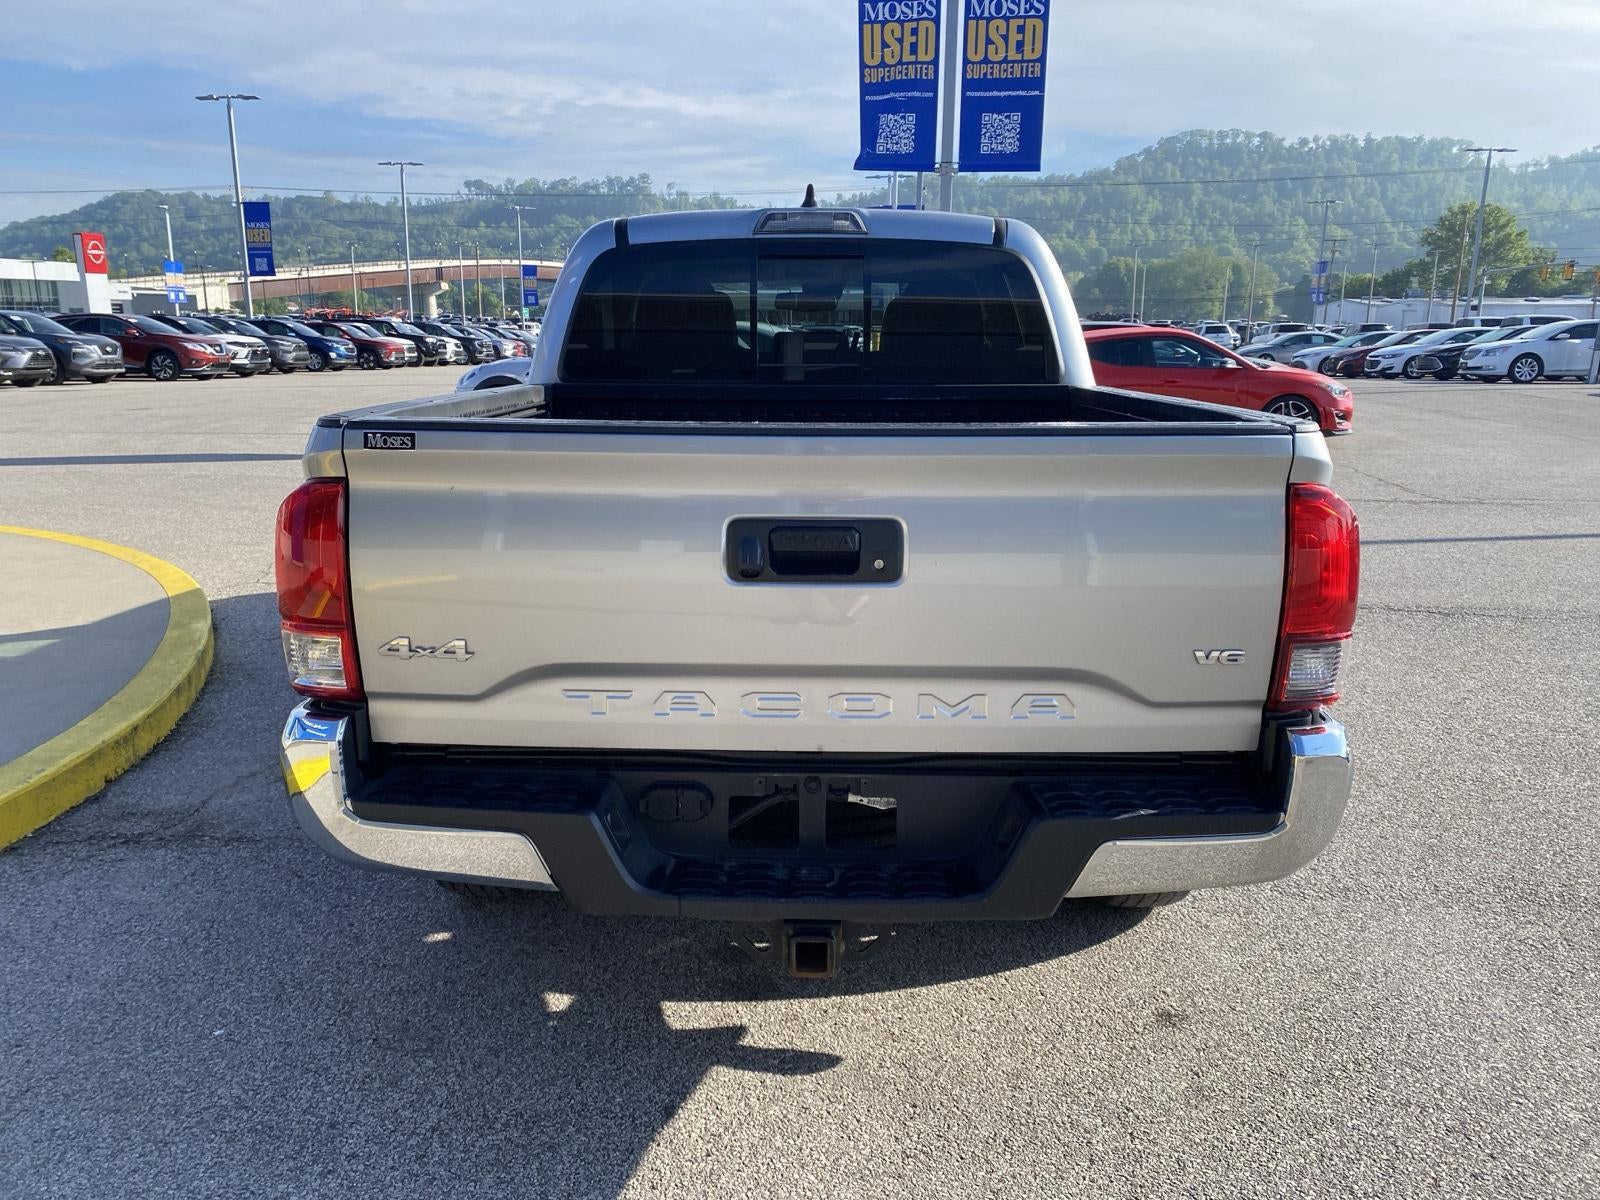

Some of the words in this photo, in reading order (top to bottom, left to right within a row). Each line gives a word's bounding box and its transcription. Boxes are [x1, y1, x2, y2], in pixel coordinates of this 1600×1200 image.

[863, 0, 937, 21] MOSES
[969, 0, 1045, 18] MOSES
[863, 20, 936, 66] USED
[966, 19, 1044, 62] USED
[864, 64, 935, 83] SUPERCENTER
[966, 63, 1041, 79] SUPERCENTER
[247, 228, 271, 243] USED
[378, 635, 475, 662] 4x4
[1192, 648, 1246, 665] V6
[562, 688, 1077, 719] TACOMA
